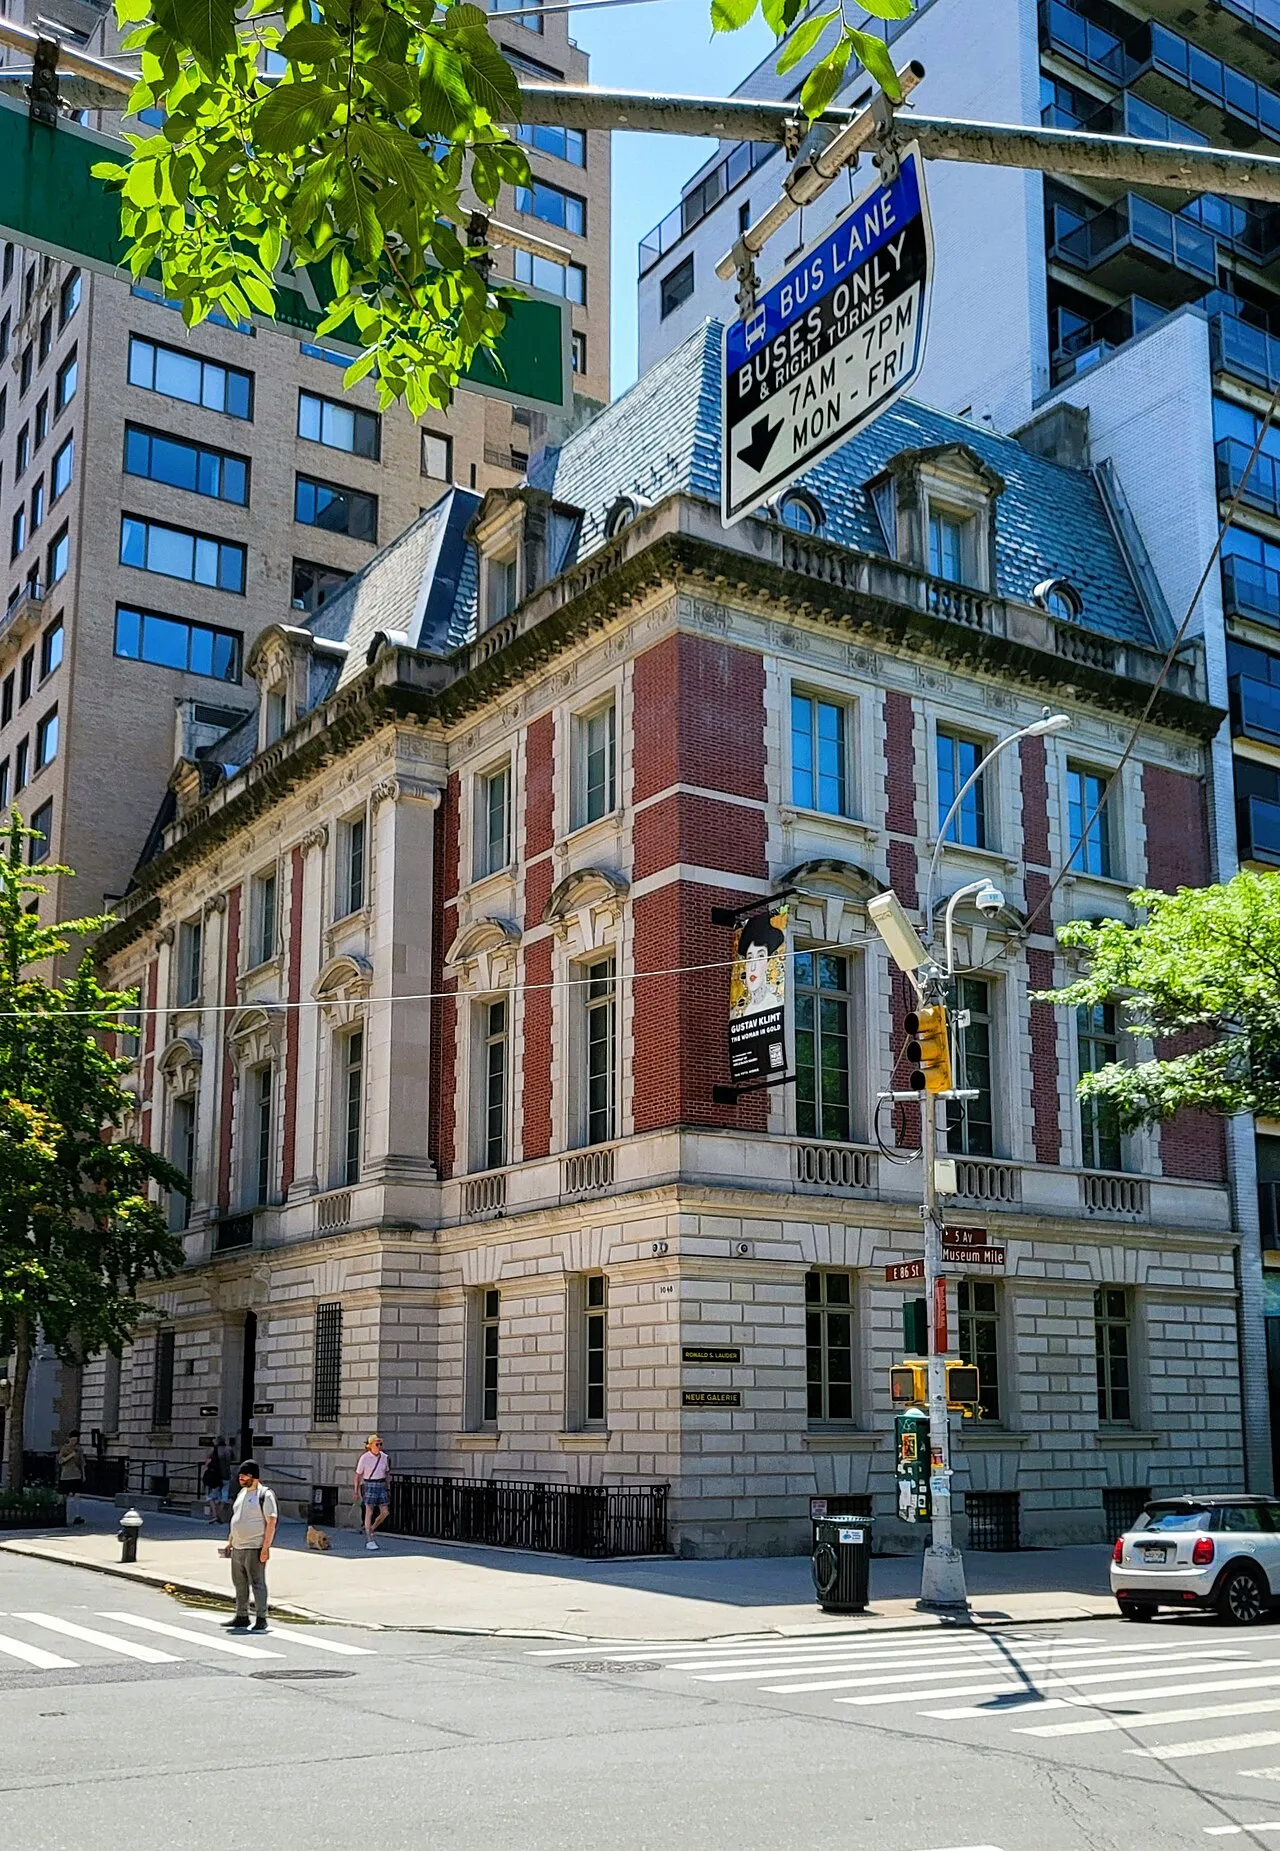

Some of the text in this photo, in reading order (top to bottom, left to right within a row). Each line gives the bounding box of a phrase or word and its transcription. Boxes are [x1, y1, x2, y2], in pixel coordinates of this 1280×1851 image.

[780, 189, 897, 317] BUS LANE
[738, 230, 906, 399] BUSES ONLY
[759, 288, 885, 401] & RIGHT TURNS
[788, 356, 836, 416] 7AM
[861, 302, 913, 360] 7PM
[792, 392, 841, 455] MON
[867, 342, 904, 398] FRI
[731, 1012, 782, 1034] GUSTAV KLIMT
[731, 1024, 781, 1043] THE WOMAN IN GOLD
[955, 1230, 973, 1243] 5 Av
[942, 1247, 1004, 1263] Museum Mile
[893, 1264, 920, 1280] E 86 St
[685, 1393, 738, 1402] NEUE GALERIE
